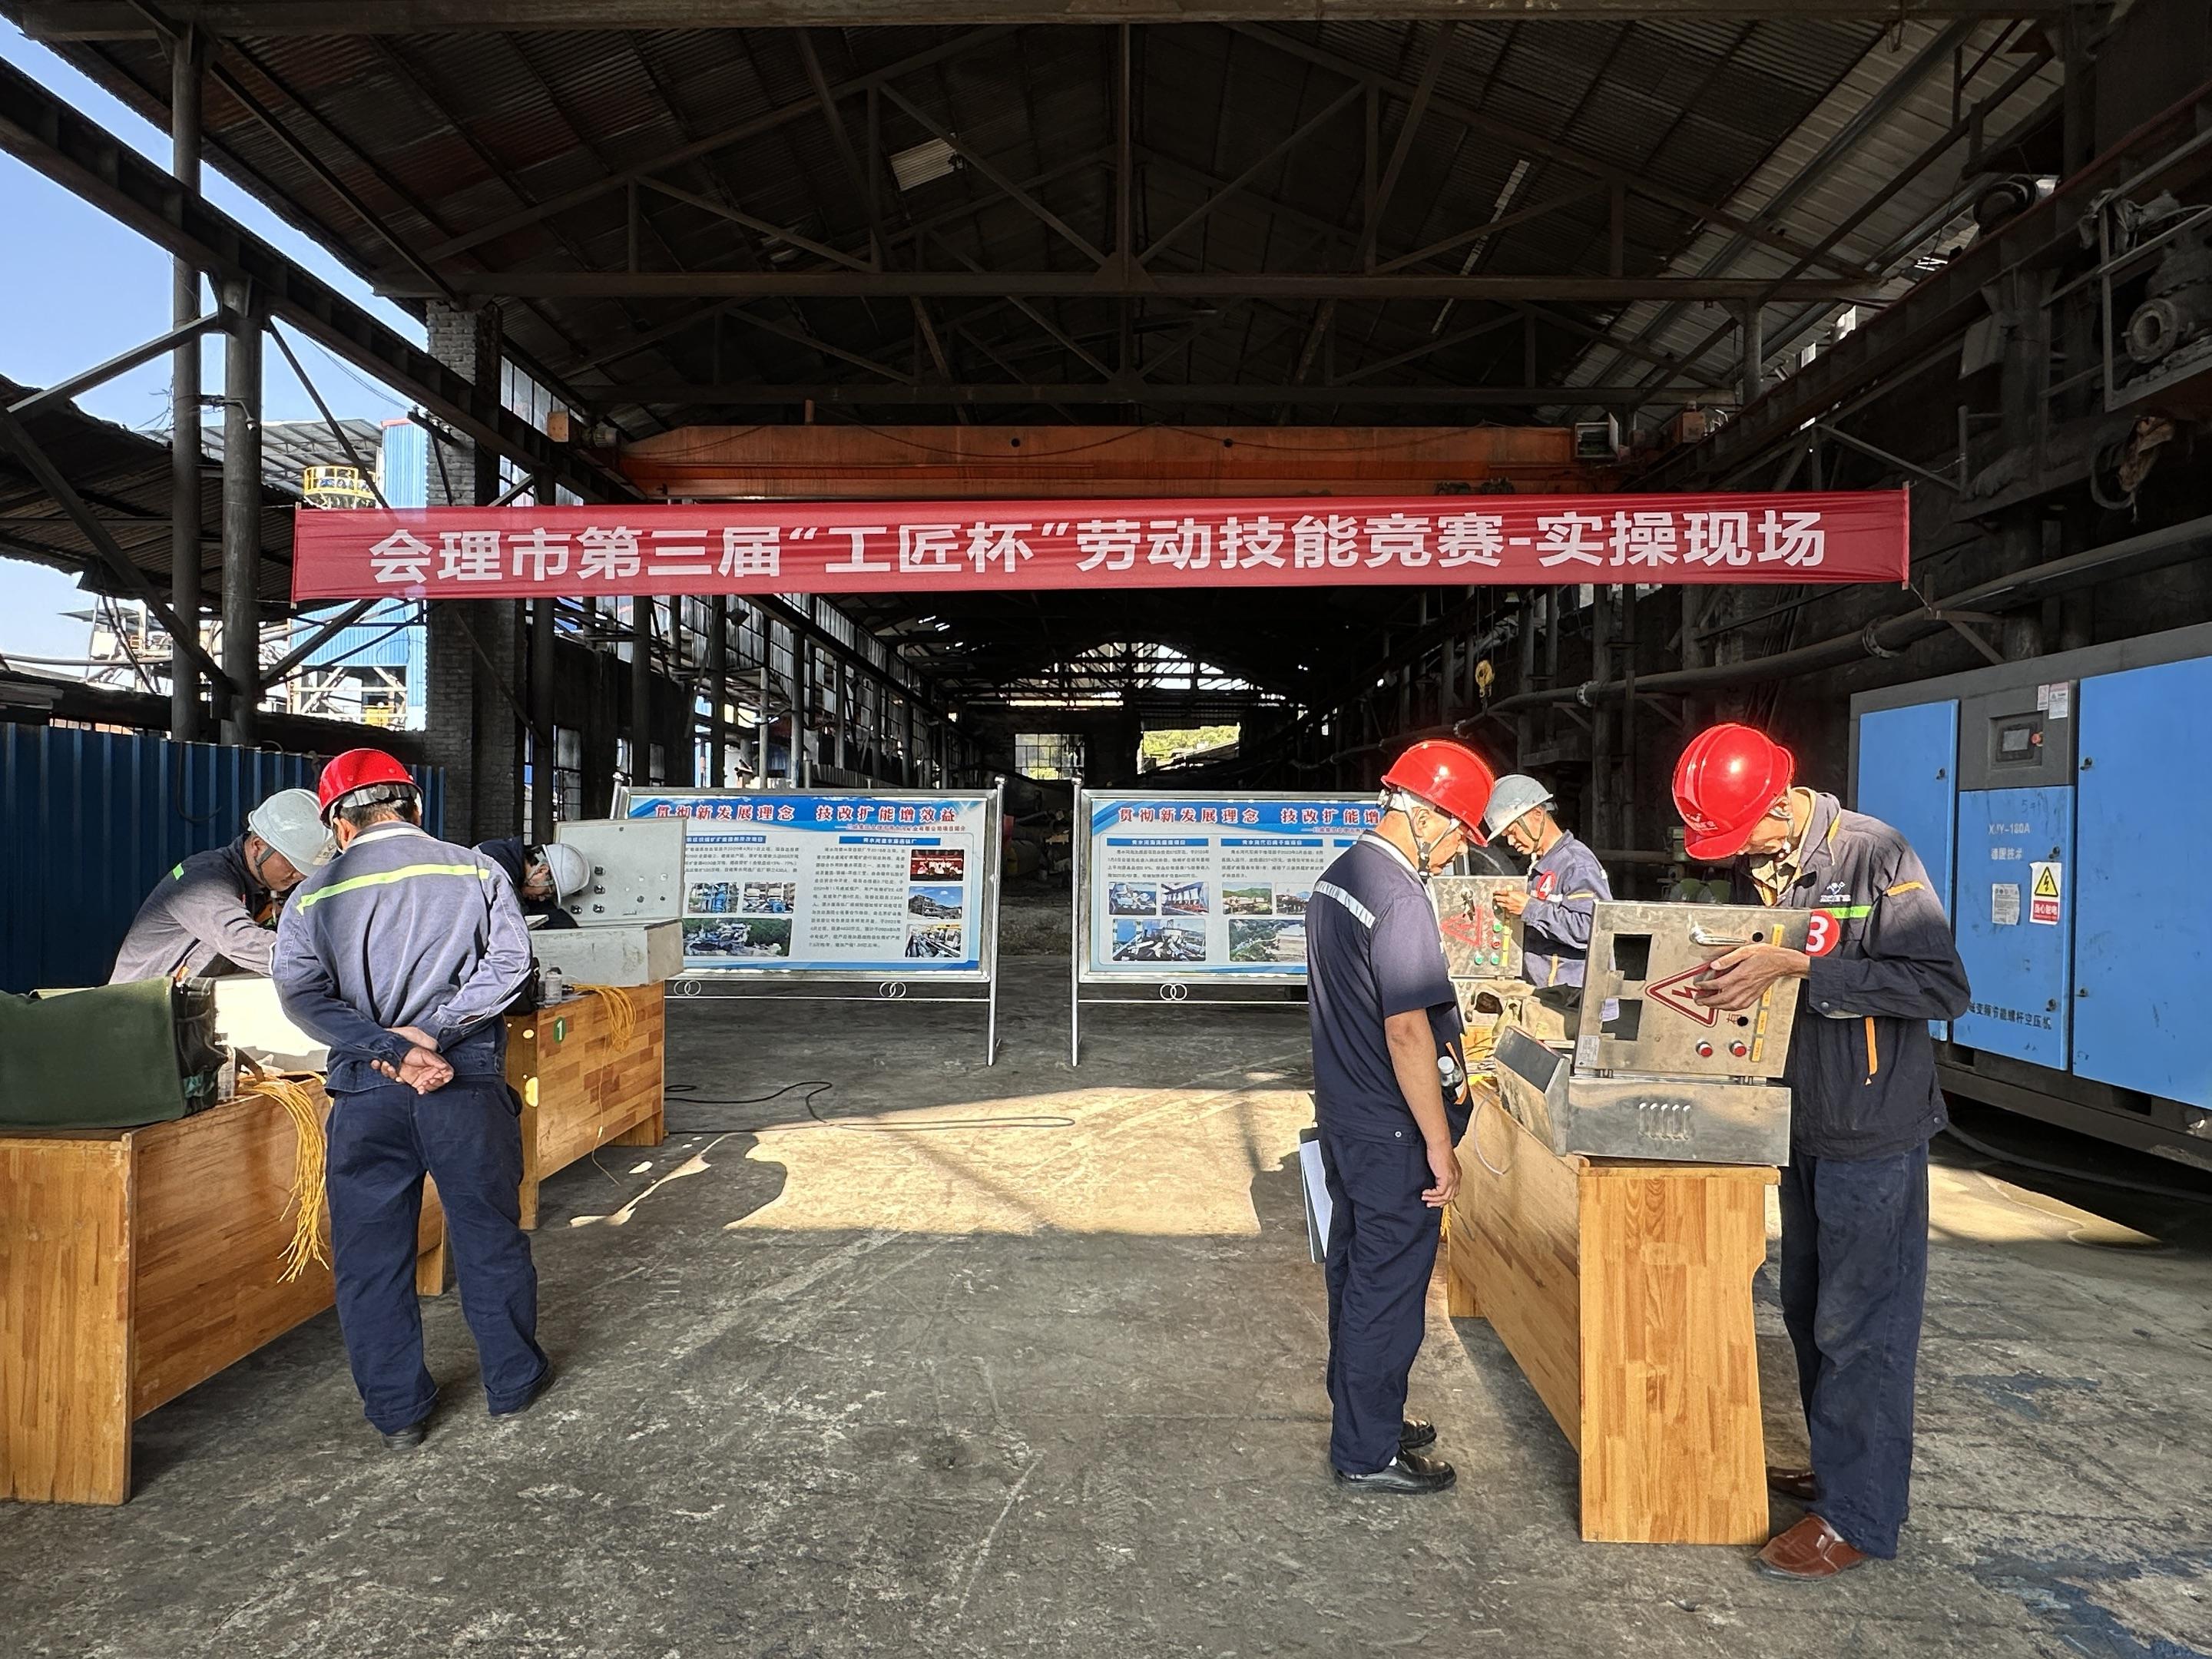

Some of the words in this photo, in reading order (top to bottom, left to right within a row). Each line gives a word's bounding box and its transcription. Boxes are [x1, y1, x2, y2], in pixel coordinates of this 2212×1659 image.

[657, 804, 795, 822] 贯彻新发展理念
[816, 806, 956, 822] 技改扩能增效益
[1119, 807, 1259, 823] 贯彻新发展理念
[1281, 807, 1379, 824] 技改扩能增
[1539, 875, 1552, 897] 4
[1806, 916, 1829, 952] 3
[557, 1020, 563, 1040] 1
